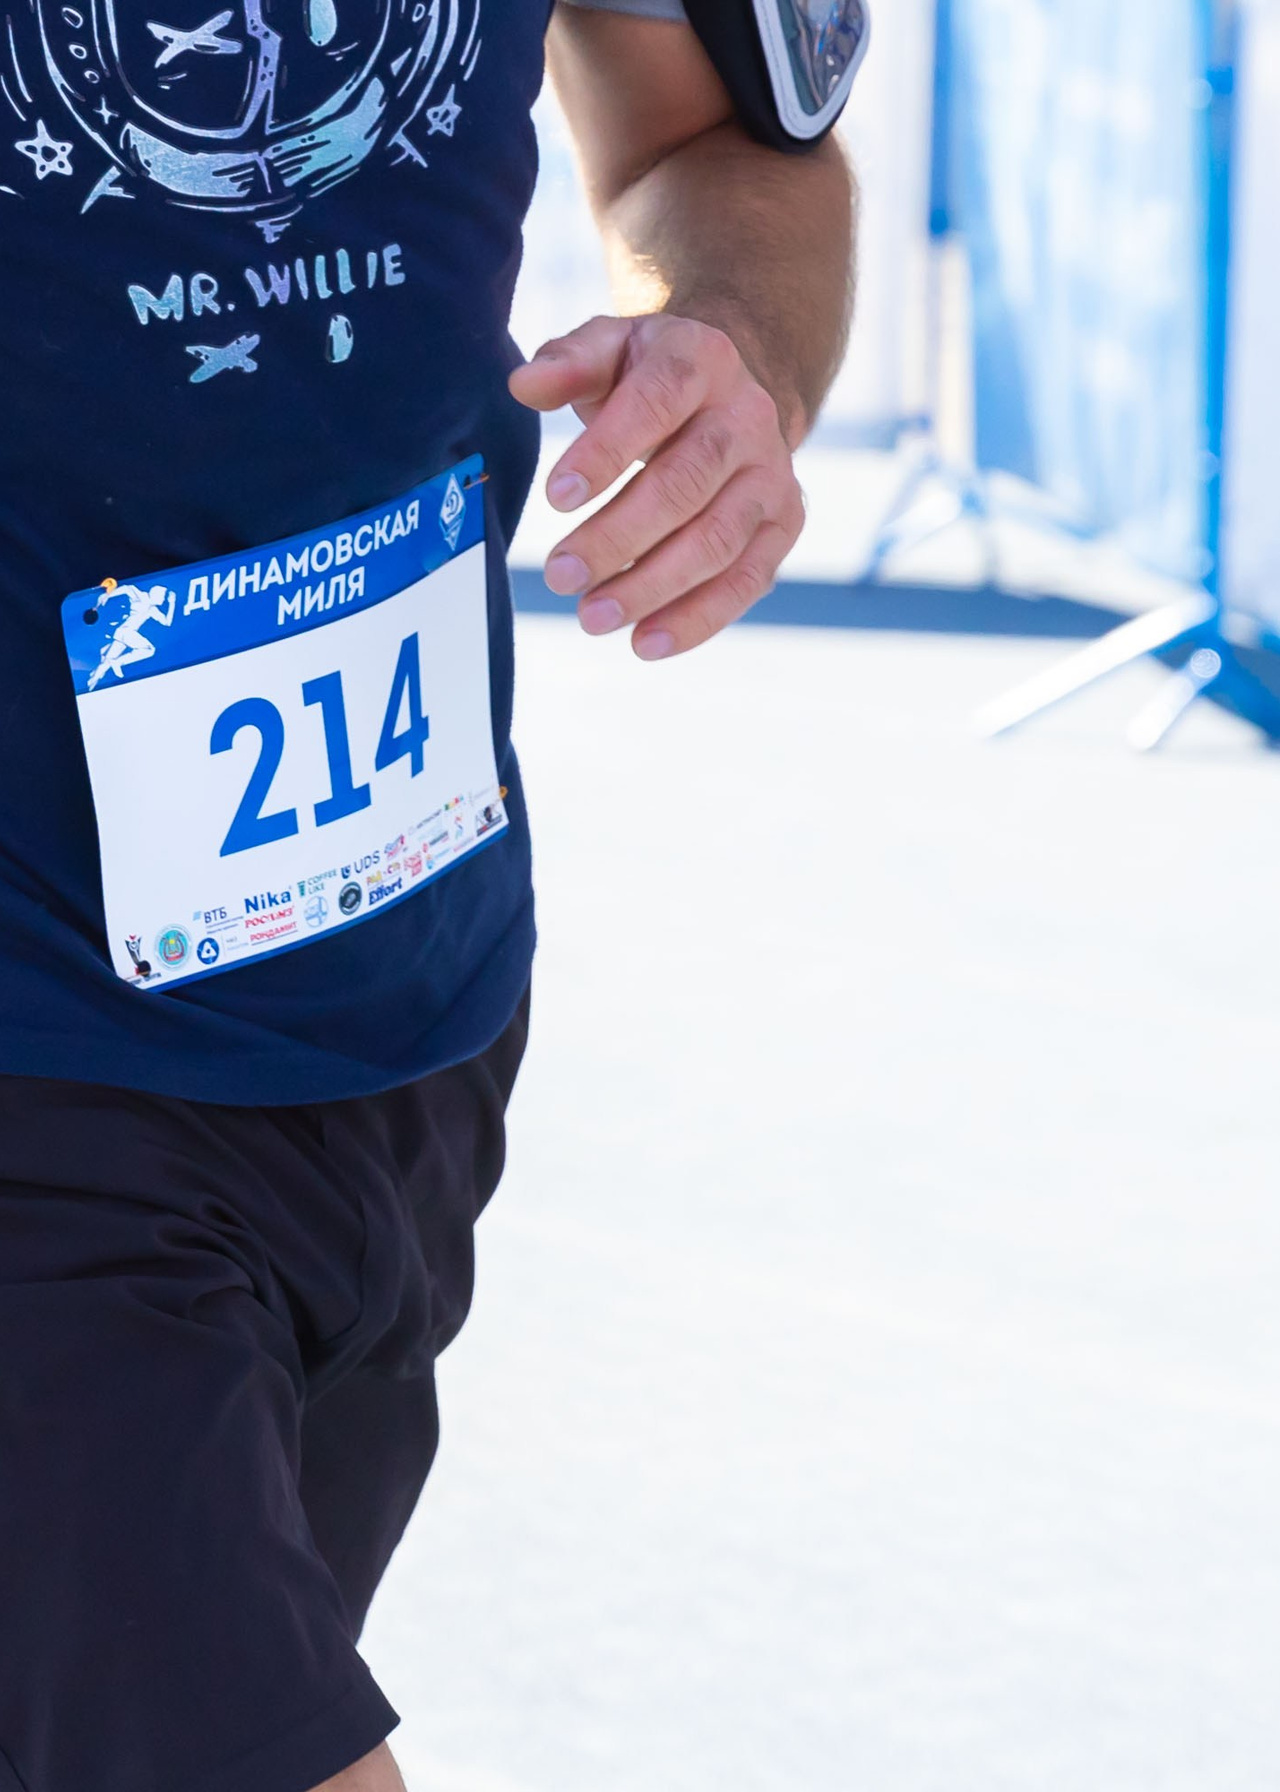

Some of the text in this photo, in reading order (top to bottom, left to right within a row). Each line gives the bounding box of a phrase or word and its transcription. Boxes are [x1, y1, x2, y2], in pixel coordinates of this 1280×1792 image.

[128, 244, 407, 326] MR. WILLIE
[183, 498, 421, 616] ДИНАМОВСКАЯ
[276, 565, 366, 626] МИЛЯ
[209, 631, 431, 858] 214
[355, 851, 380, 874] UDS
[244, 890, 292, 914] Nika
[369, 878, 402, 905] Effort
[204, 906, 227, 924] ВТБ
